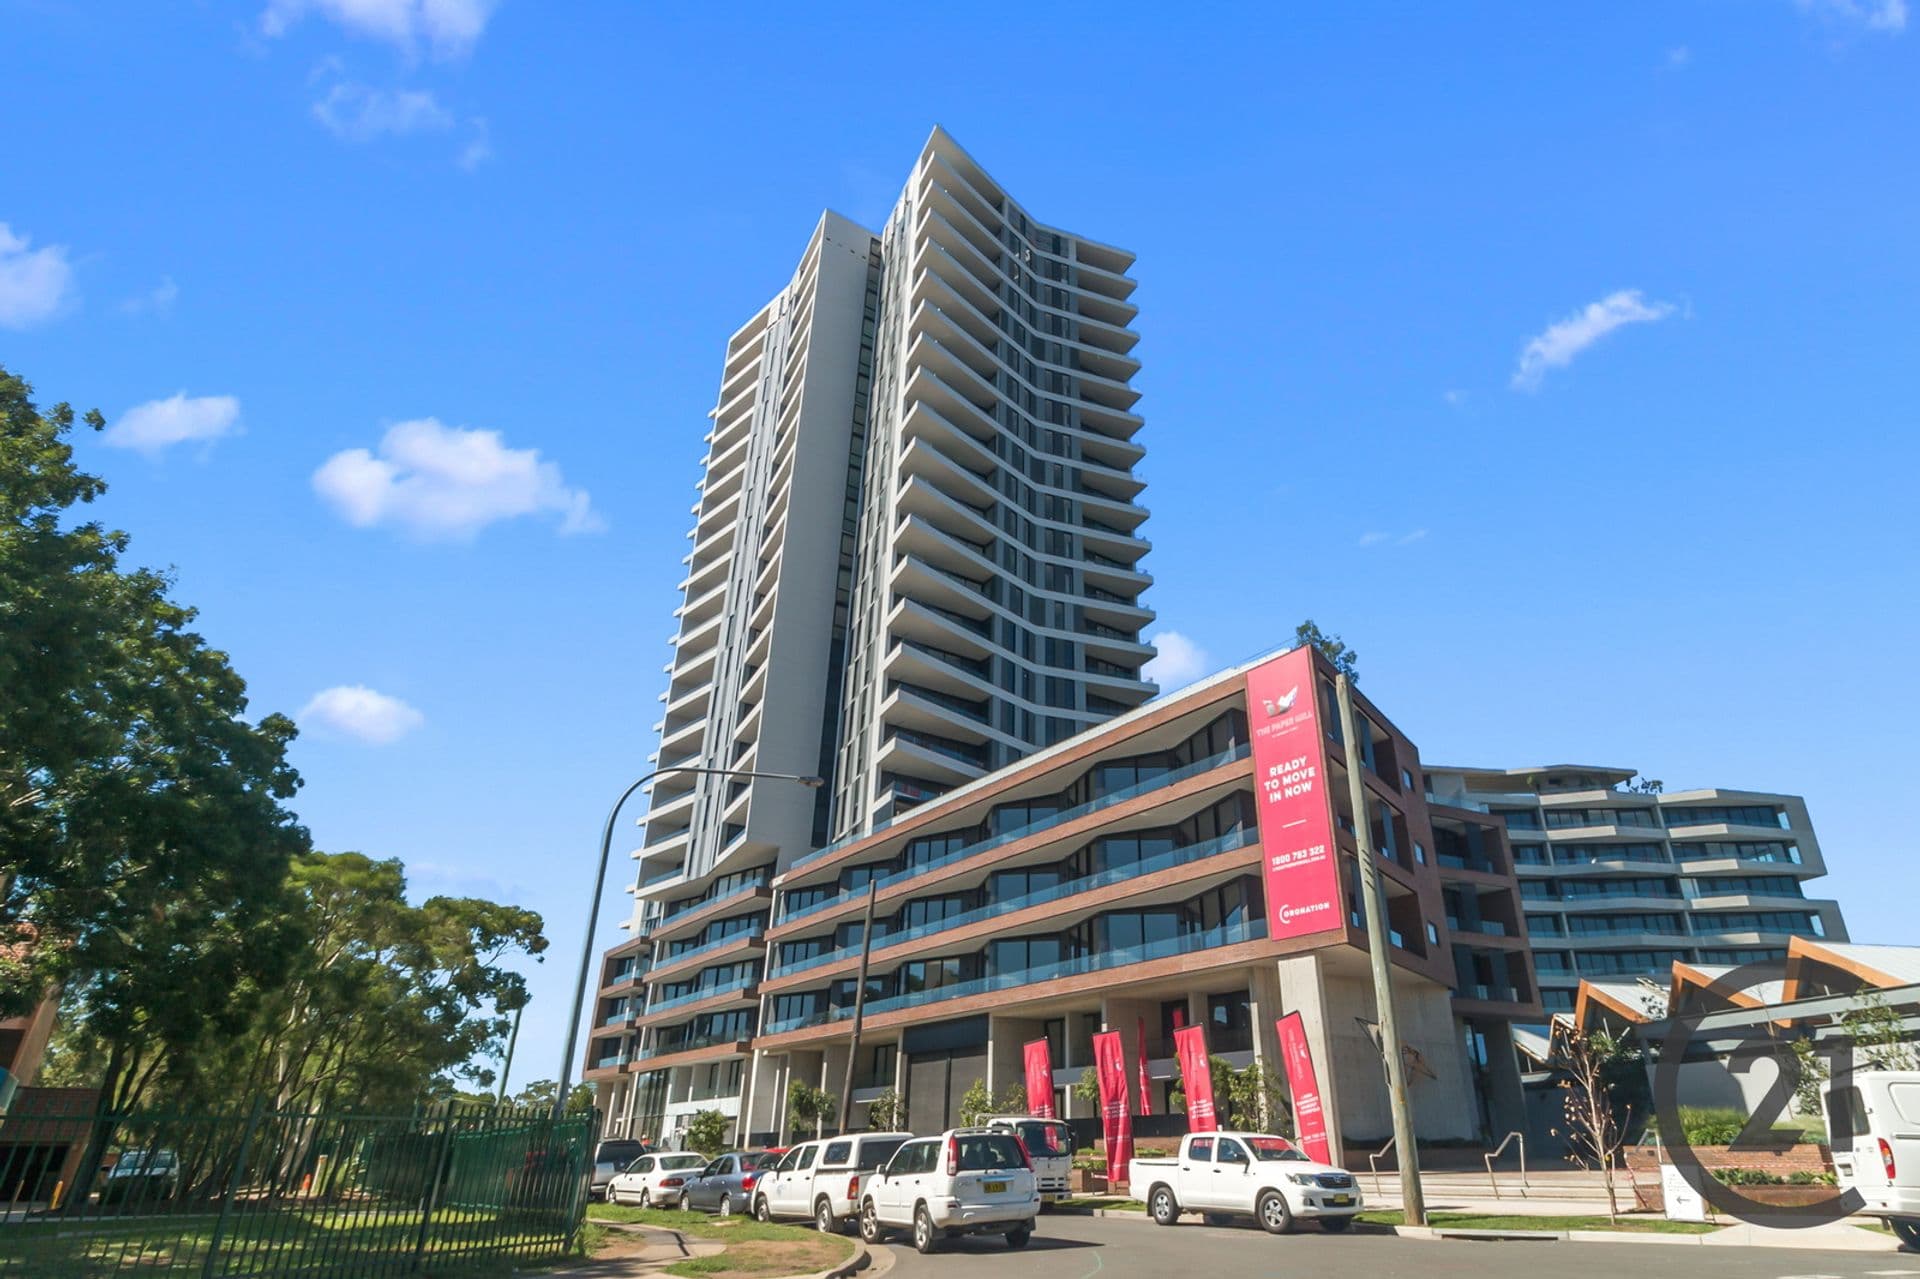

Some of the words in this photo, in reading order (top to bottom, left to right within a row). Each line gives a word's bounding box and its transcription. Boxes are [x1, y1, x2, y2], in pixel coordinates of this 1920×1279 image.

[1270, 757, 1307, 777] READY
[1264, 779, 1280, 791] TO
[1283, 767, 1315, 786] MOVE
[1270, 791, 1281, 803] IN
[1285, 782, 1313, 798] NOW
[1272, 854, 1291, 866] 1800
[1279, 902, 1330, 924] CORONATION
